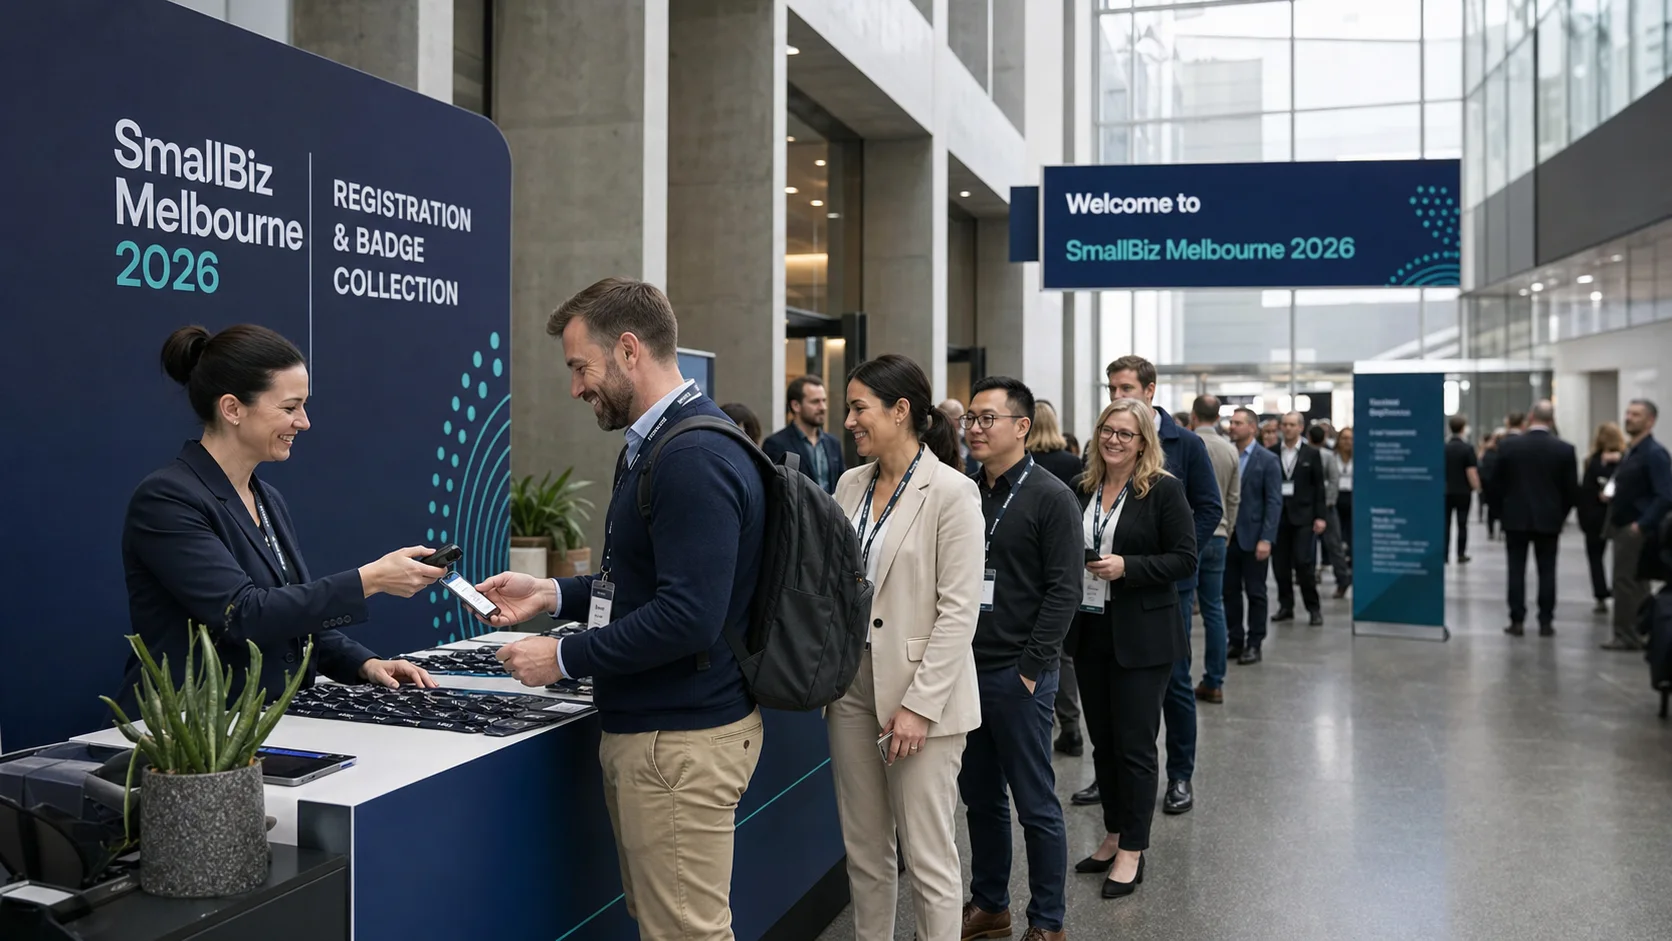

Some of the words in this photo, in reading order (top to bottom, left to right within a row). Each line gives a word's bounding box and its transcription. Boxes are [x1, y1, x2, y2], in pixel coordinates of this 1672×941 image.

[113, 118, 274, 197] SmallBiz
[115, 176, 304, 251] Melbourne
[333, 178, 472, 233] REGISTRATION
[1065, 191, 1174, 215] Welcome
[1175, 192, 1202, 214] to
[333, 222, 350, 252] &
[356, 226, 425, 263] BADGE
[1065, 238, 1161, 262] SmallBiz
[1165, 238, 1286, 261] Melbourne
[1290, 236, 1355, 260] 2026
[115, 240, 220, 294] 2026
[333, 266, 459, 306] COLLECTION
